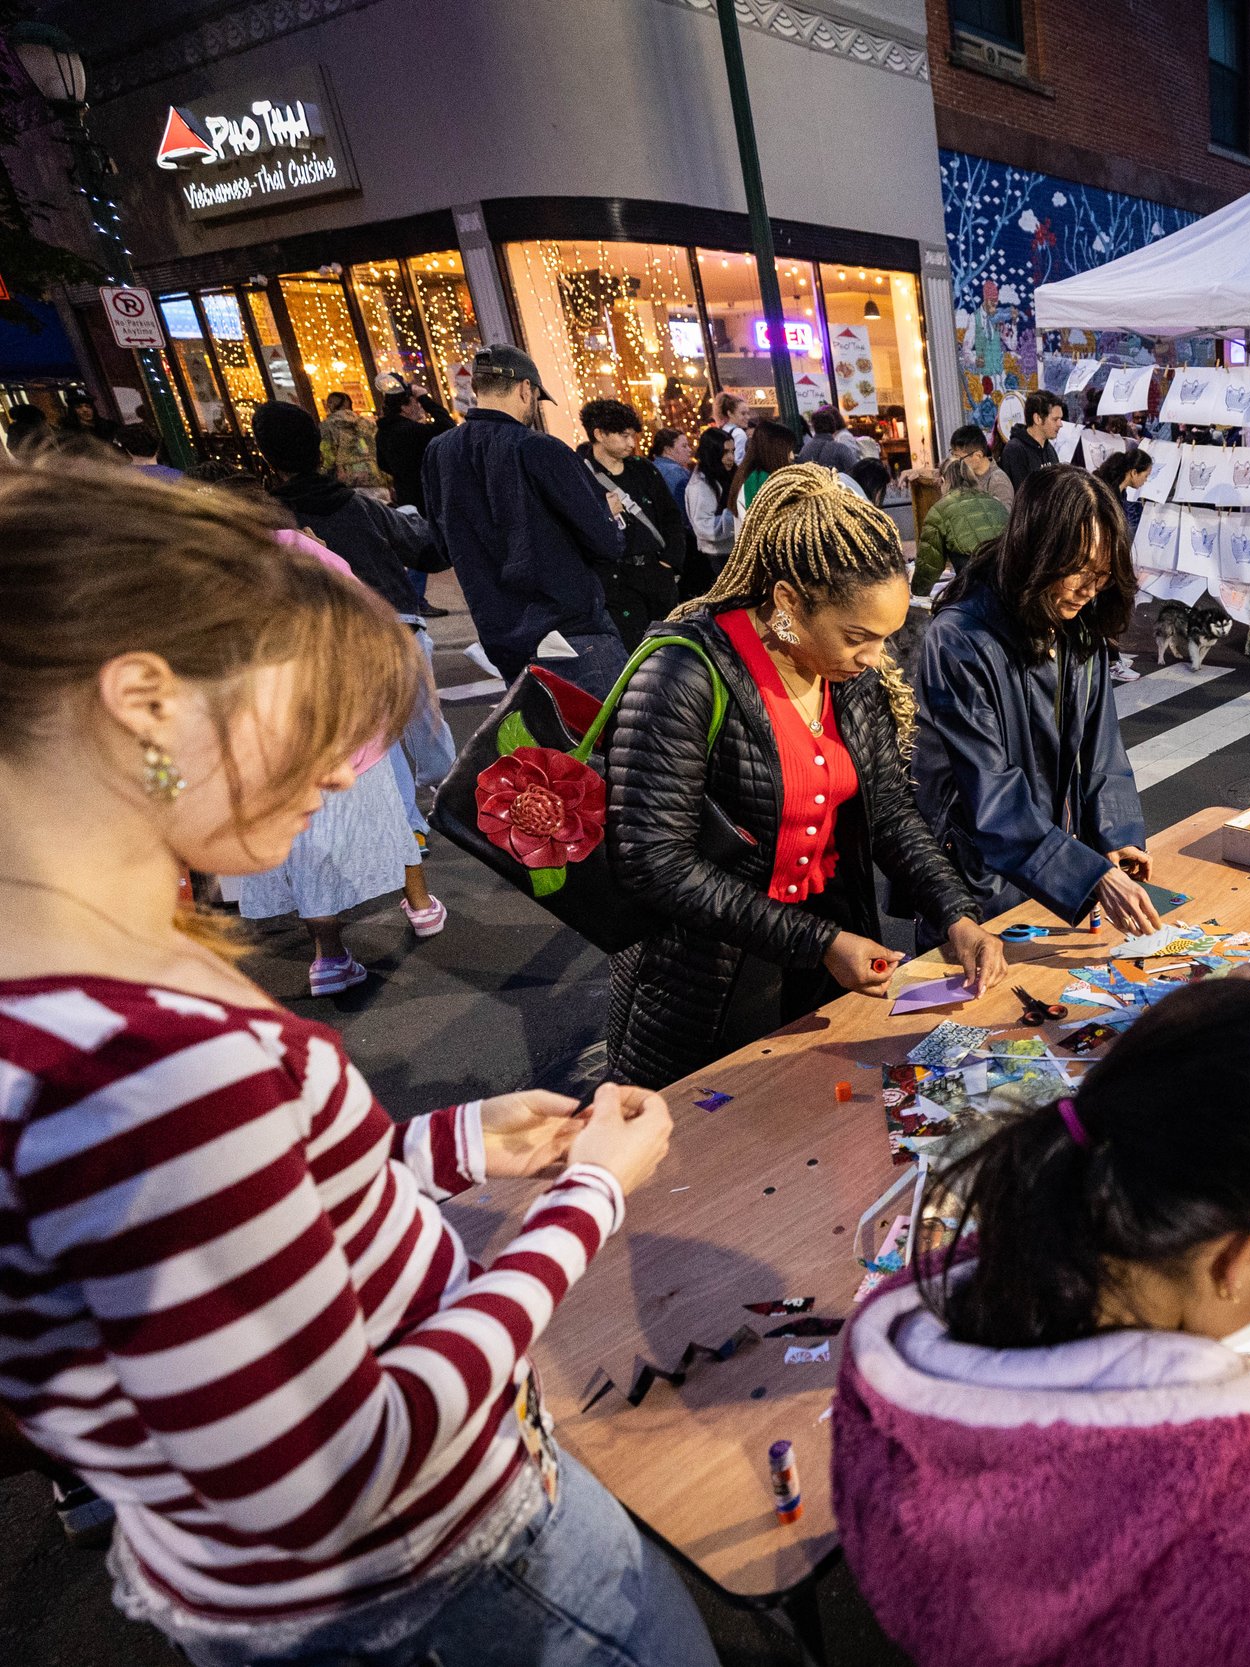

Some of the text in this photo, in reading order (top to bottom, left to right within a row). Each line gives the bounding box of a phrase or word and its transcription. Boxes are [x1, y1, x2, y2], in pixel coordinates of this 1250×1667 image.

[205, 115, 261, 160] PHO
[183, 152, 337, 209] Vietnamese-Thai Cuisine
[122, 327, 153, 336] Anytime
[127, 319, 155, 328] Parking
